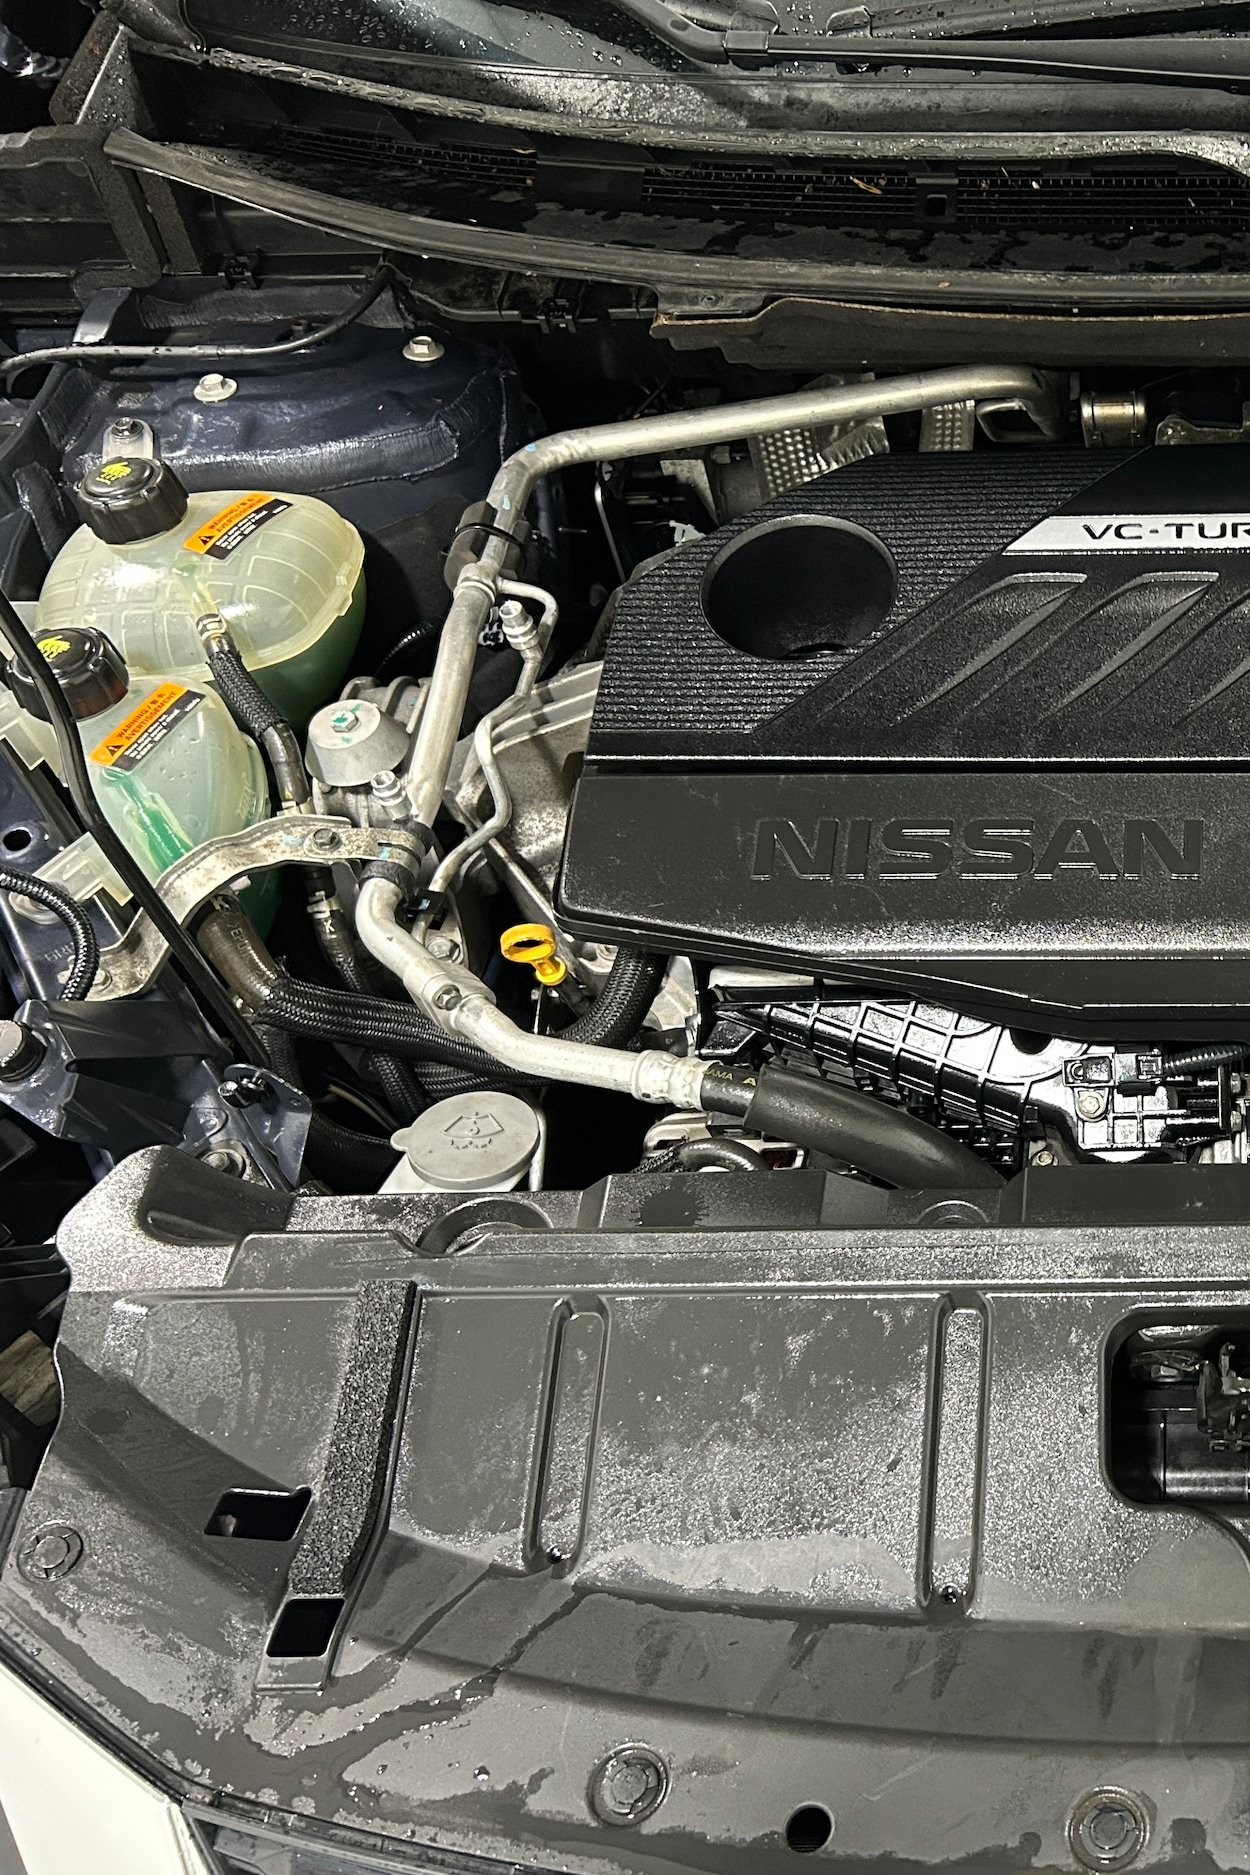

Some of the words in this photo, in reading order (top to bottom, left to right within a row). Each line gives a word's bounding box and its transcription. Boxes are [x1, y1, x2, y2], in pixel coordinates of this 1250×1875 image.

[117, 709, 149, 738] WARNING
[125, 692, 176, 741] AVERTISSEMENT
[751, 818, 1204, 880] NISSAN
